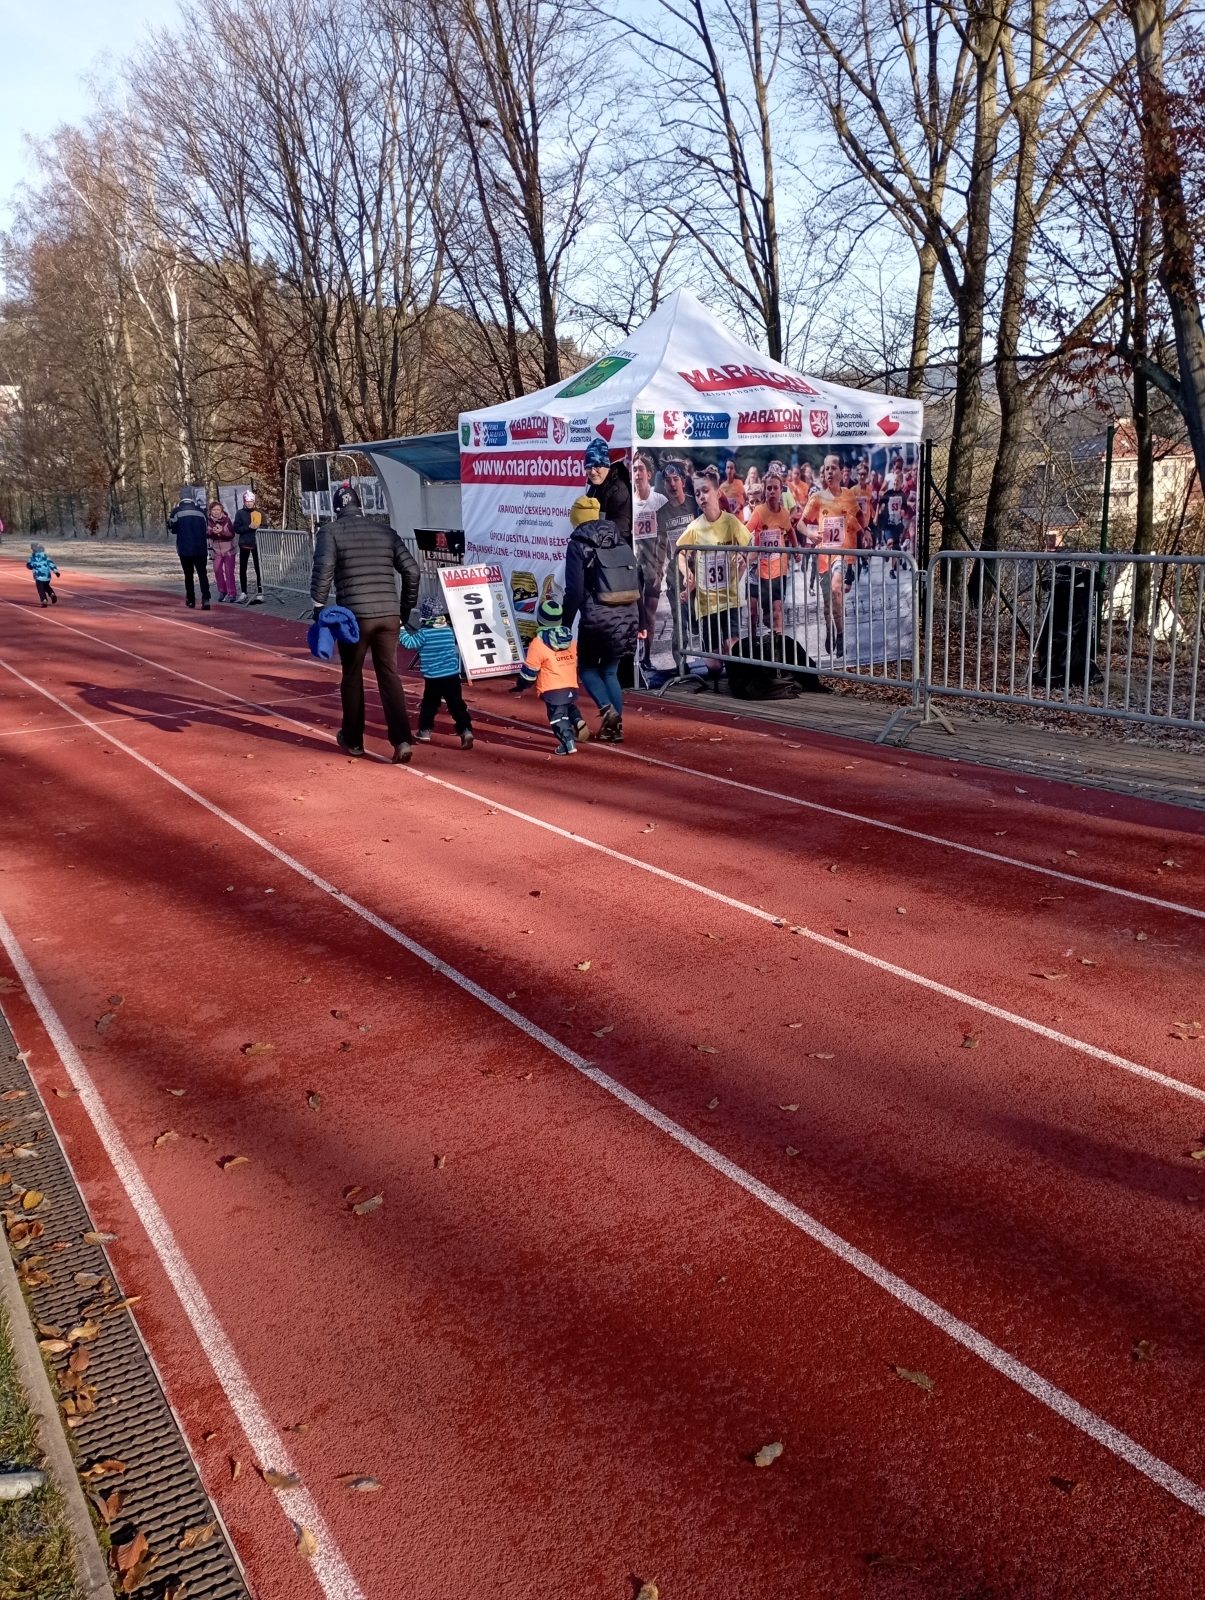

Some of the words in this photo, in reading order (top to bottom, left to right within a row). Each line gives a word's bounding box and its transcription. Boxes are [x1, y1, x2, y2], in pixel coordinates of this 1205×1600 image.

[677, 364, 809, 388] MARATON
[784, 385, 814, 394] stav
[694, 414, 715, 422] ČESKÝ
[738, 408, 802, 423] MARATON
[509, 416, 549, 431] MARATON
[695, 421, 729, 429] ATLETICKÝ
[836, 420, 870, 428] SPORTOVNÍ
[472, 455, 587, 477] www.maratonstav
[524, 505, 551, 516] ČESKÉHO
[552, 507, 571, 517] POHÁR
[638, 521, 652, 534] 28
[531, 535, 548, 546] ZIMNÍ
[549, 537, 571, 547] BĚŽEC
[829, 528, 840, 542] 12
[442, 566, 501, 581] MARATON
[708, 566, 724, 584] 33
[463, 593, 497, 665] START
